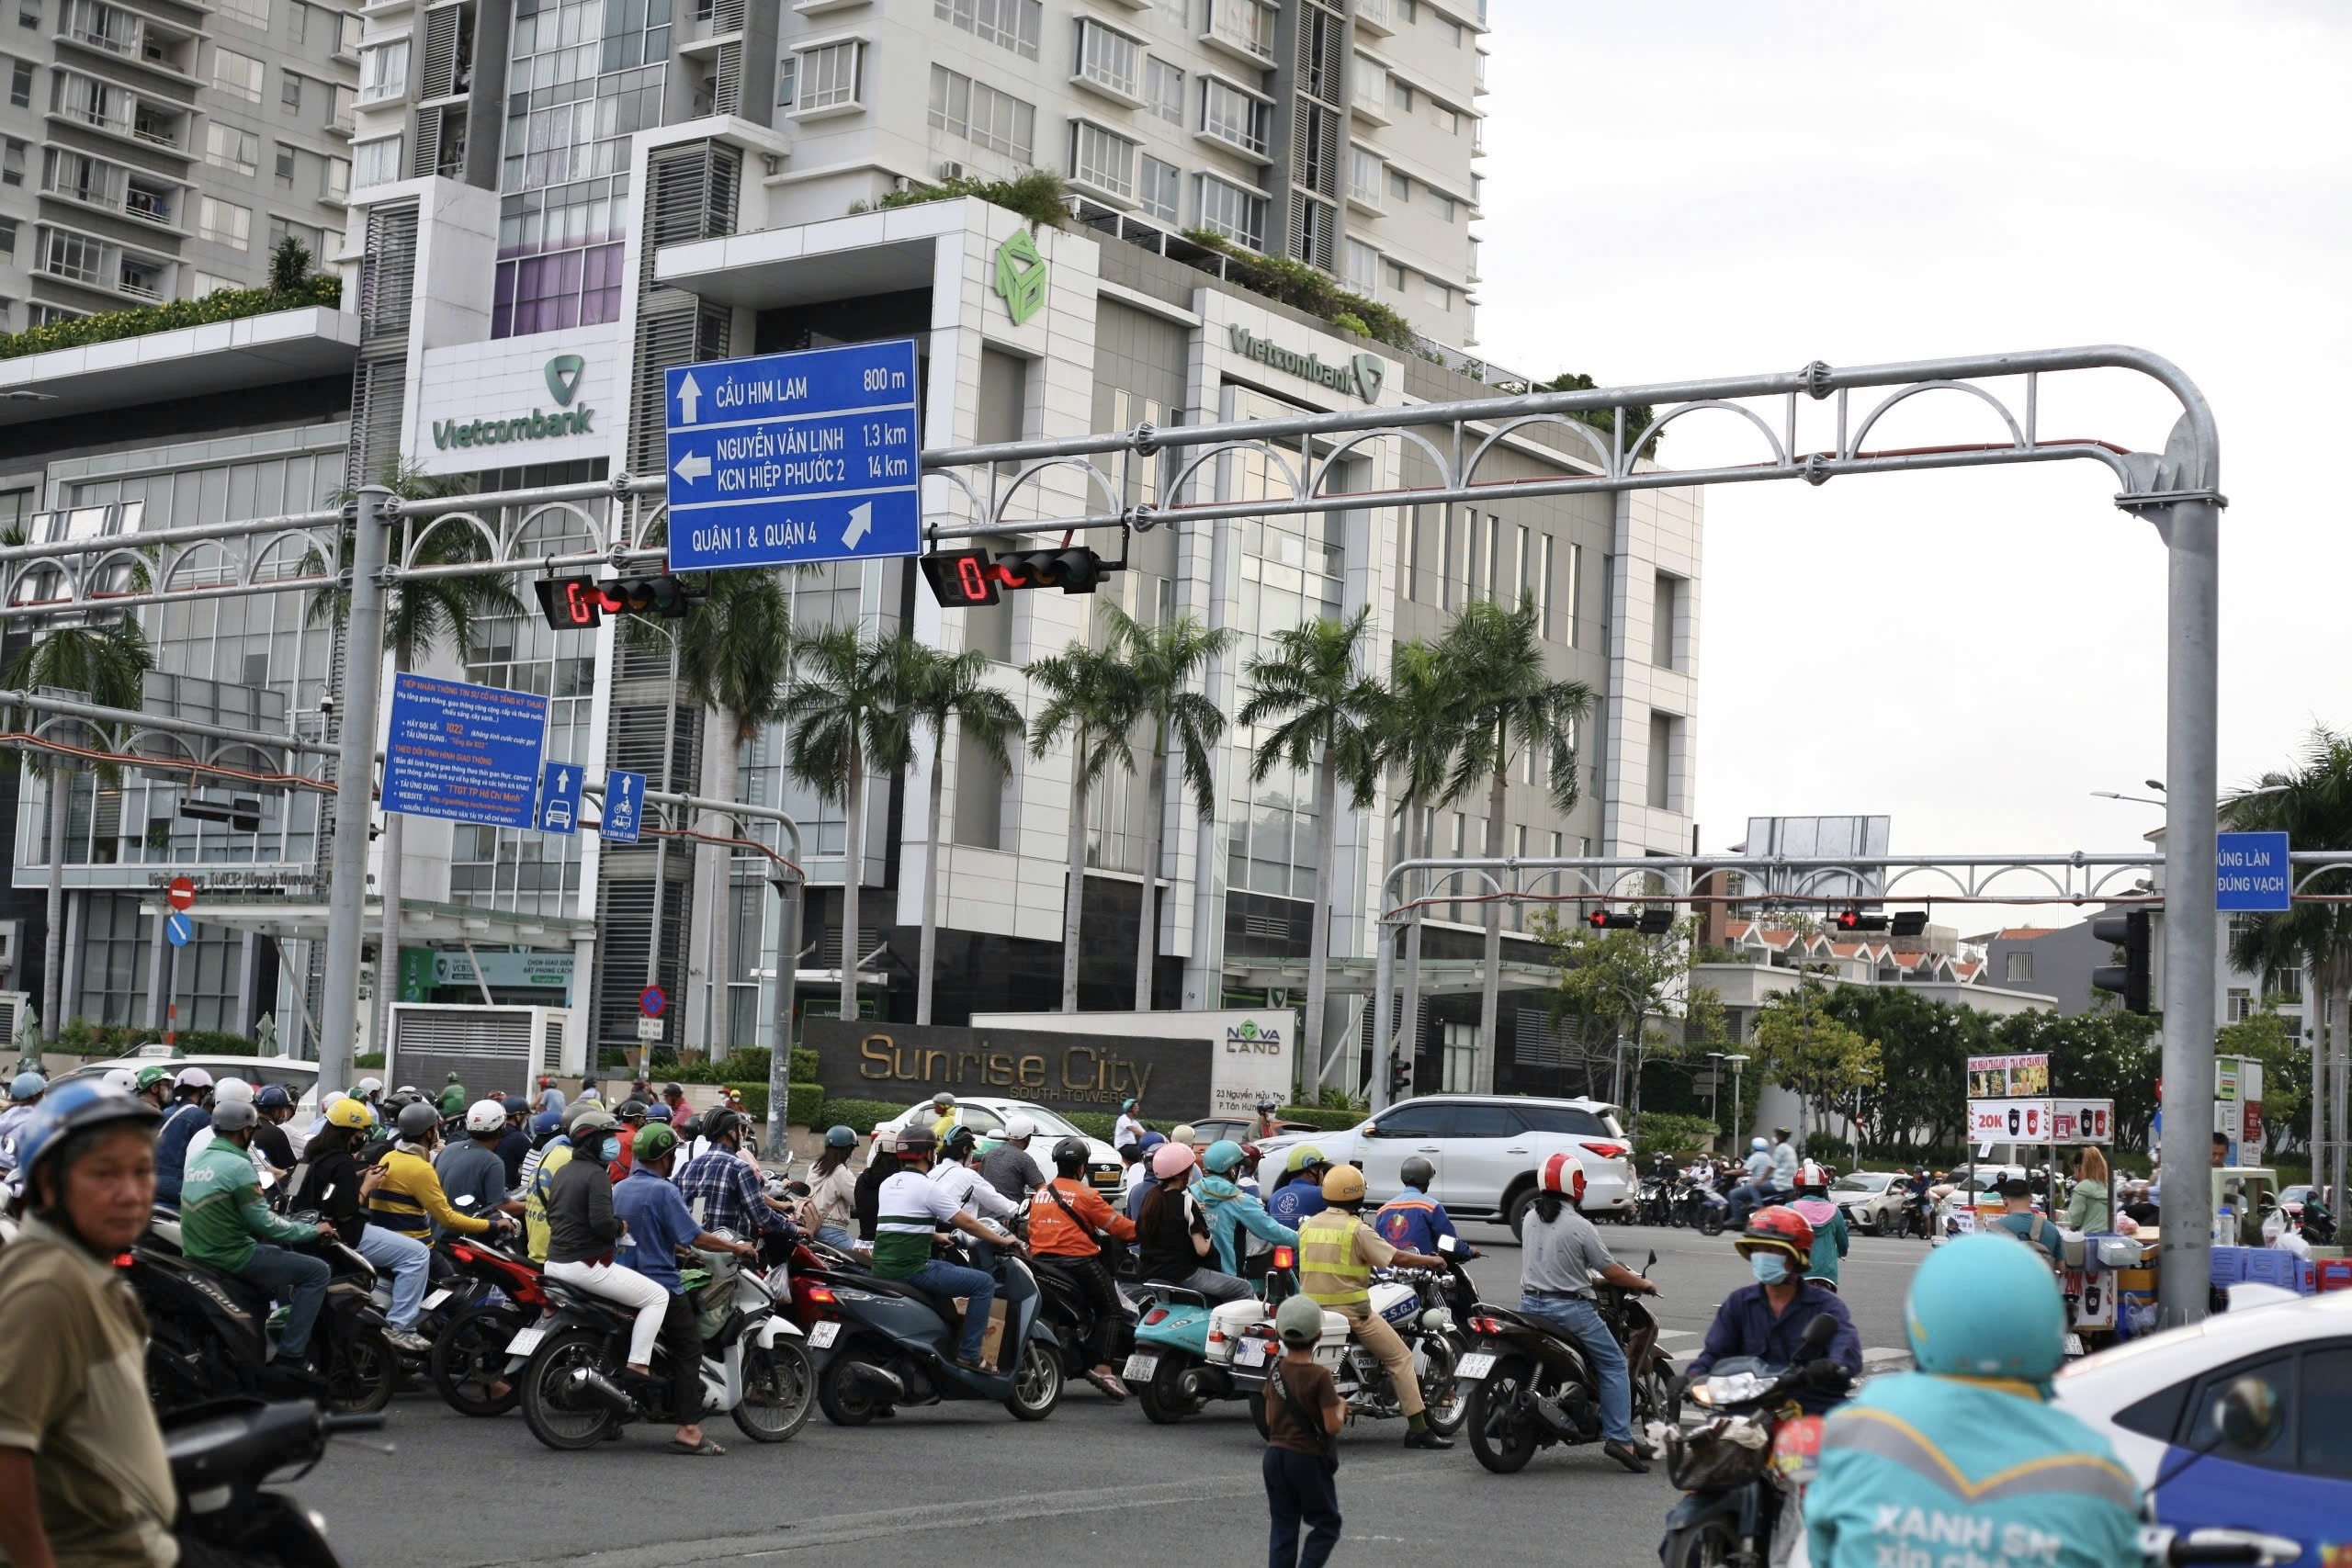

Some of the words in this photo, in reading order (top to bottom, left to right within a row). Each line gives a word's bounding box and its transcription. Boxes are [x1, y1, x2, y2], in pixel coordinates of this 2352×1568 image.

[1229, 322, 1358, 395] Vietcombank
[864, 367, 887, 391] 800
[892, 371, 905, 389] m
[716, 376, 744, 408] CẦU
[748, 380, 773, 405] HIM
[777, 377, 808, 401] LAM
[433, 401, 595, 450] Vietcombank
[863, 423, 881, 447] 1.3
[885, 423, 907, 445] km
[717, 427, 774, 461] NGUYỄN
[777, 427, 807, 455] VĂN
[810, 428, 843, 452] LINH
[718, 468, 745, 491] KCN
[750, 460, 781, 491] HIỆP
[786, 454, 834, 486] PHƯỚC
[837, 459, 845, 481] 2
[867, 456, 882, 479] 14
[886, 455, 908, 476] km
[692, 524, 731, 555] QUẬN
[735, 526, 741, 548] 1
[748, 526, 758, 547] &
[764, 519, 805, 549] QUẬN
[808, 522, 817, 544] 4
[447, 722, 464, 735] 1022
[2217, 849, 2243, 866] ÚNG
[2246, 849, 2270, 866] LÀN
[2218, 874, 2250, 891] ĐÚNG
[2253, 877, 2284, 894] VẠCH
[1227, 1042, 1280, 1055] LAND
[142, 1074, 156, 1083] Grab
[860, 1033, 1046, 1088] Sunrise
[1062, 1045, 1153, 1102] City
[1010, 1087, 1058, 1101] SOUTH
[1066, 1089, 1130, 1103] TOWERS
[1216, 1089, 1225, 1098] 23
[1242, 1103, 1258, 1111] Hưn
[1979, 1114, 2002, 1128] 20K
[184, 1167, 214, 1182] Grab
[1871, 1503, 1994, 1551] XANH
[2002, 1522, 2063, 1562] SM
